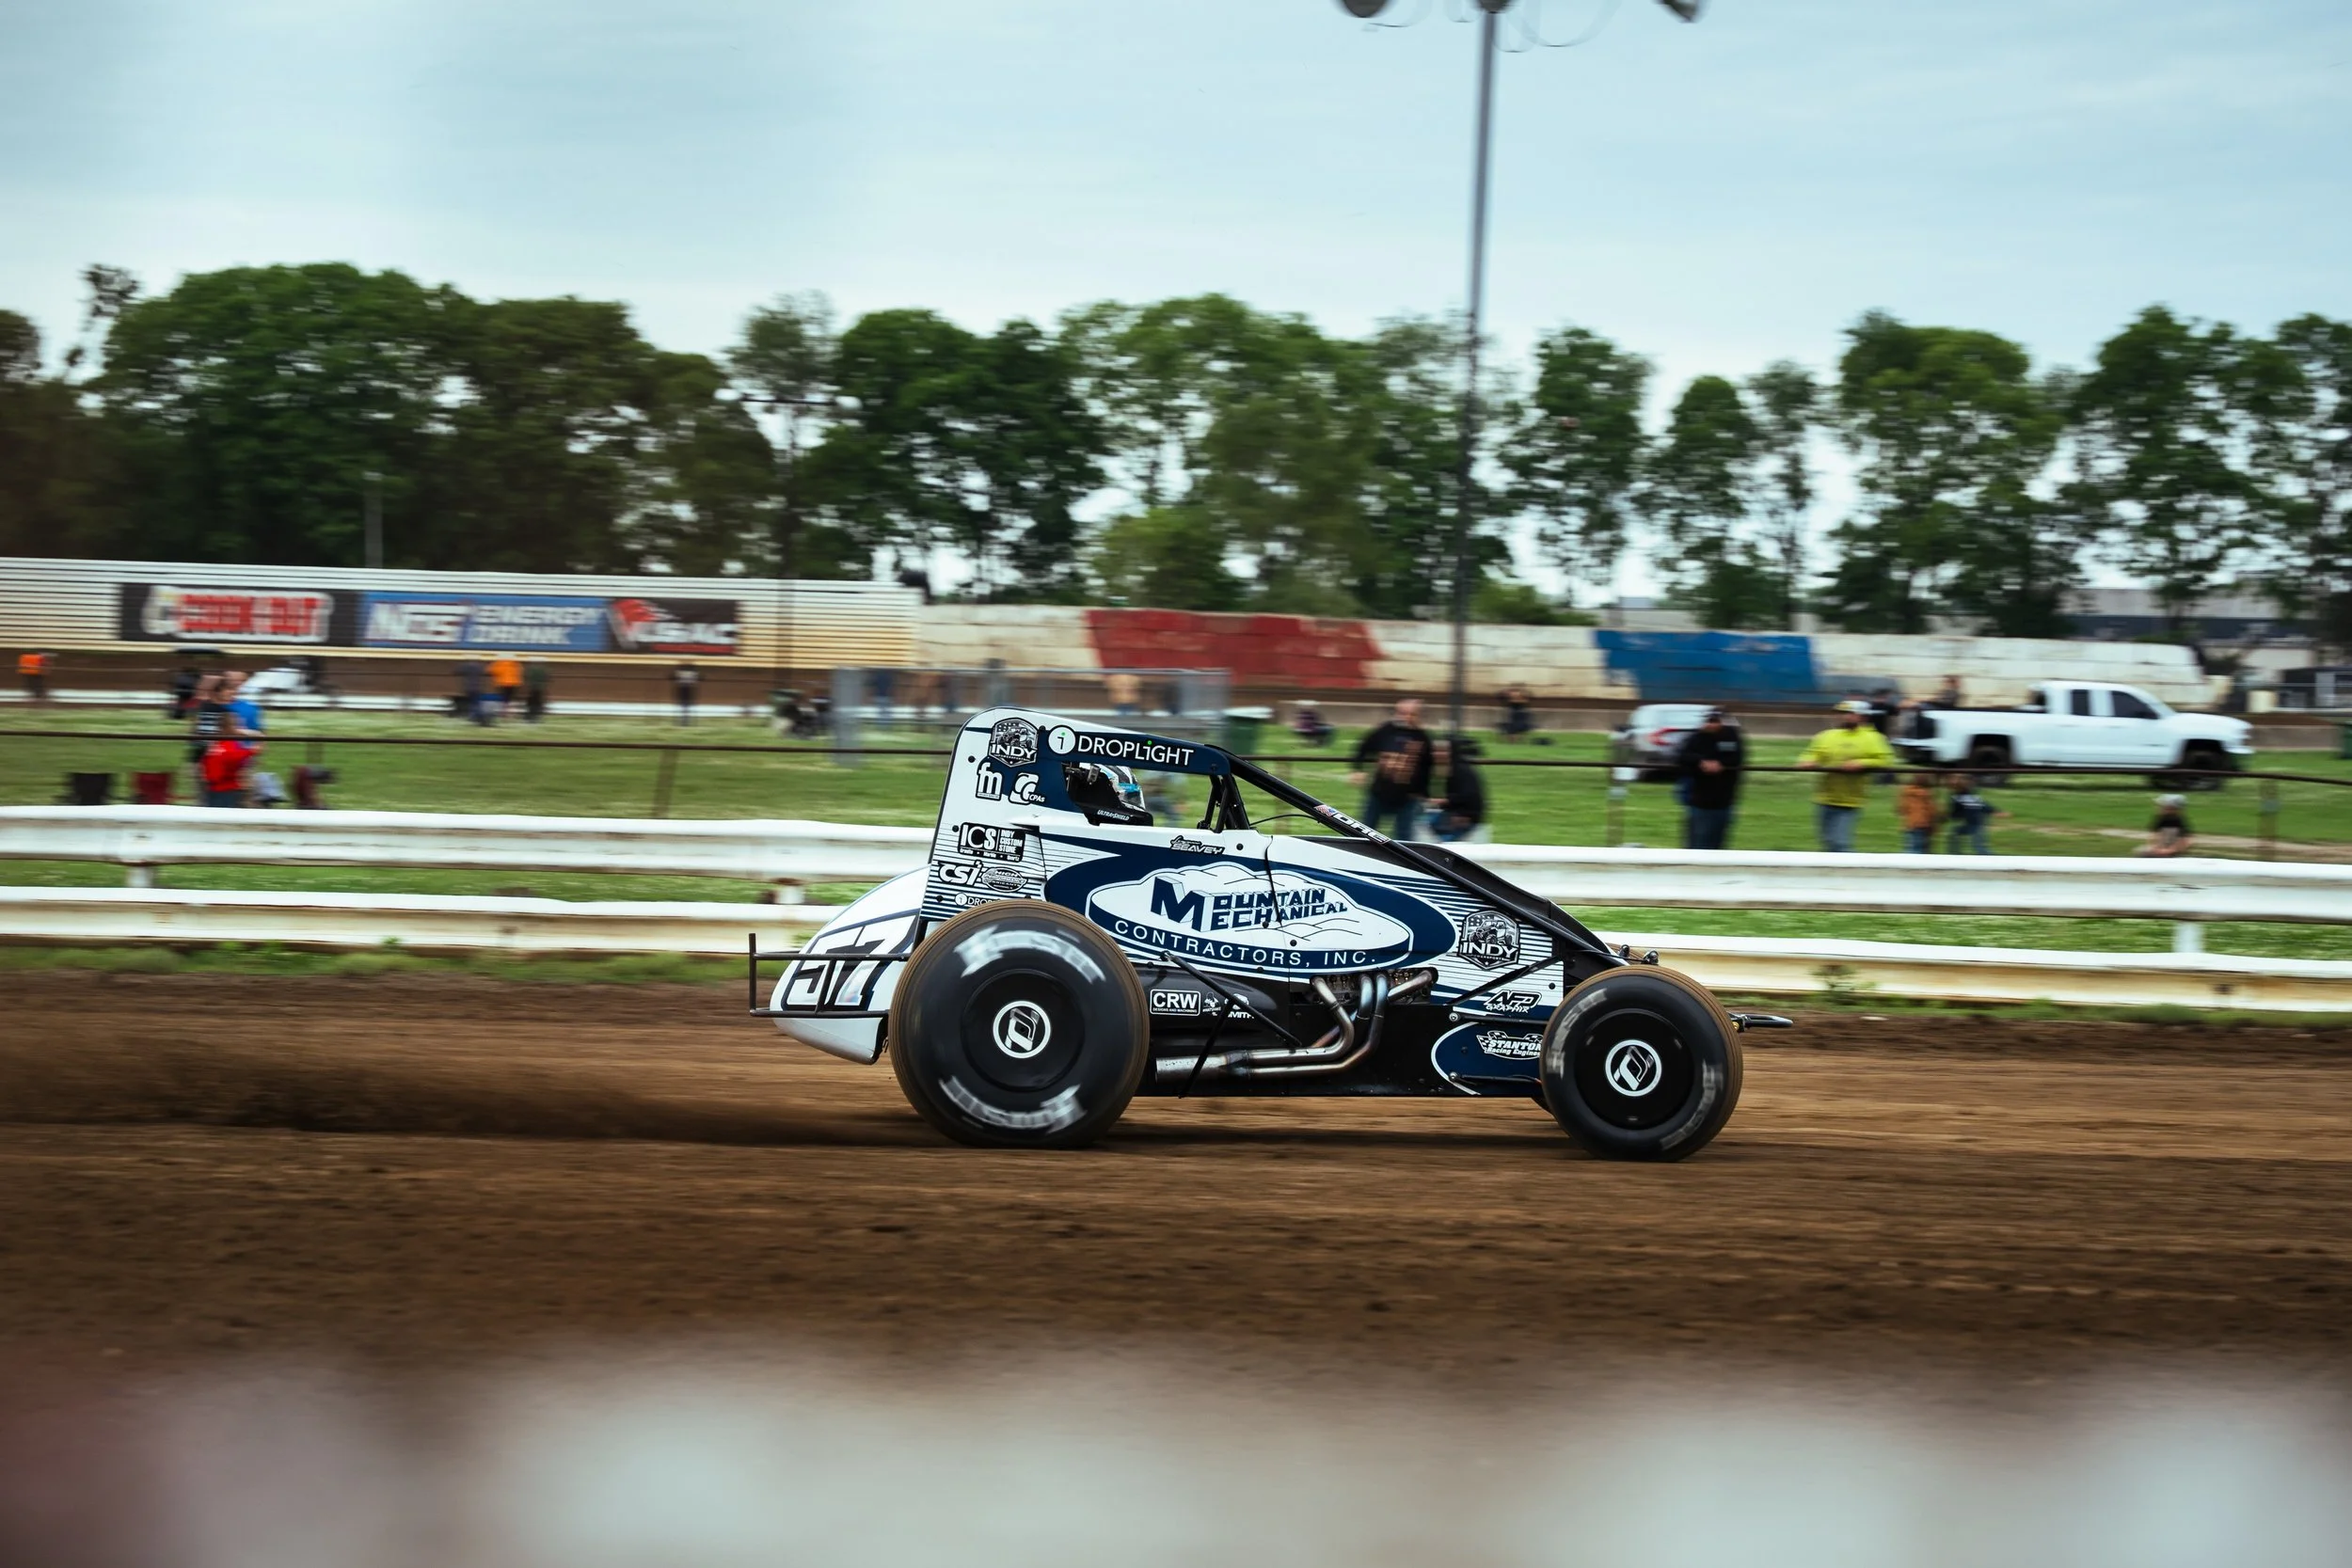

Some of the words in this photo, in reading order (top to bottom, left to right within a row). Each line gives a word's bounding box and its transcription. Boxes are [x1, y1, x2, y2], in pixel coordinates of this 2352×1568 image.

[991, 744, 1037, 759] INDY
[961, 824, 997, 850] ICS
[1115, 920, 1310, 968] CONTRACTORS,
[1324, 950, 1375, 966] INC.
[1462, 942, 1518, 958] INDY
[786, 914, 916, 1006] 57
[1152, 992, 1199, 1009] CRW
